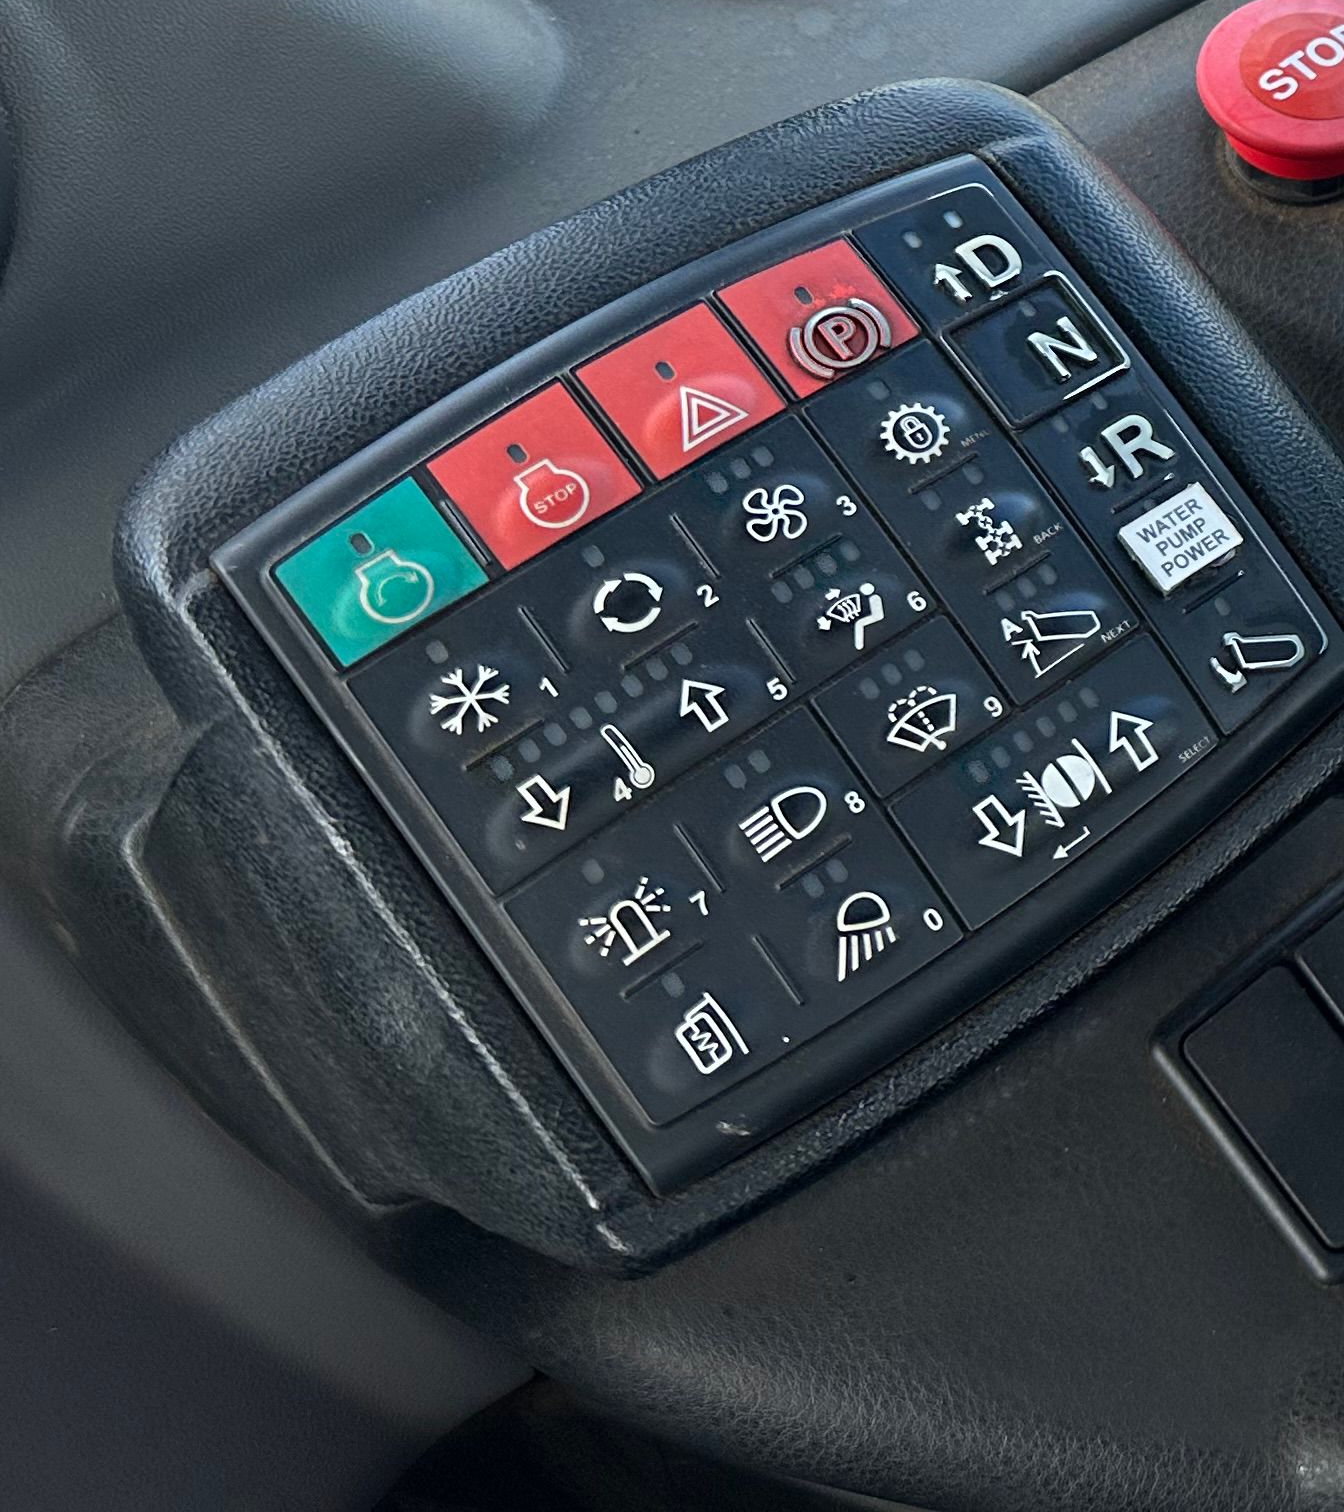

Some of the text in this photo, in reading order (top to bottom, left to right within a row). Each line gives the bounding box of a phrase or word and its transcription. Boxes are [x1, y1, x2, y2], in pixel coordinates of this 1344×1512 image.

[954, 234, 1023, 288] D
[819, 315, 855, 361] P
[1027, 315, 1097, 382] N
[1100, 414, 1176, 479] R
[533, 482, 578, 514] STOP
[836, 496, 858, 517] 3
[1136, 498, 1204, 544] WATER
[1033, 522, 1064, 545] BACK
[1155, 517, 1208, 556] PUMP
[1160, 529, 1231, 577] POWER
[697, 585, 719, 606] 2
[906, 591, 928, 611] 6
[1001, 617, 1023, 642] A
[1101, 620, 1131, 643] NEXT
[539, 677, 559, 697] 1
[767, 678, 788, 700] 5
[984, 697, 1004, 717] 9
[1178, 735, 1213, 763] SELECT
[613, 779, 632, 802] 4
[844, 792, 866, 813] 8
[689, 891, 710, 916] 7
[923, 909, 944, 931] 0
